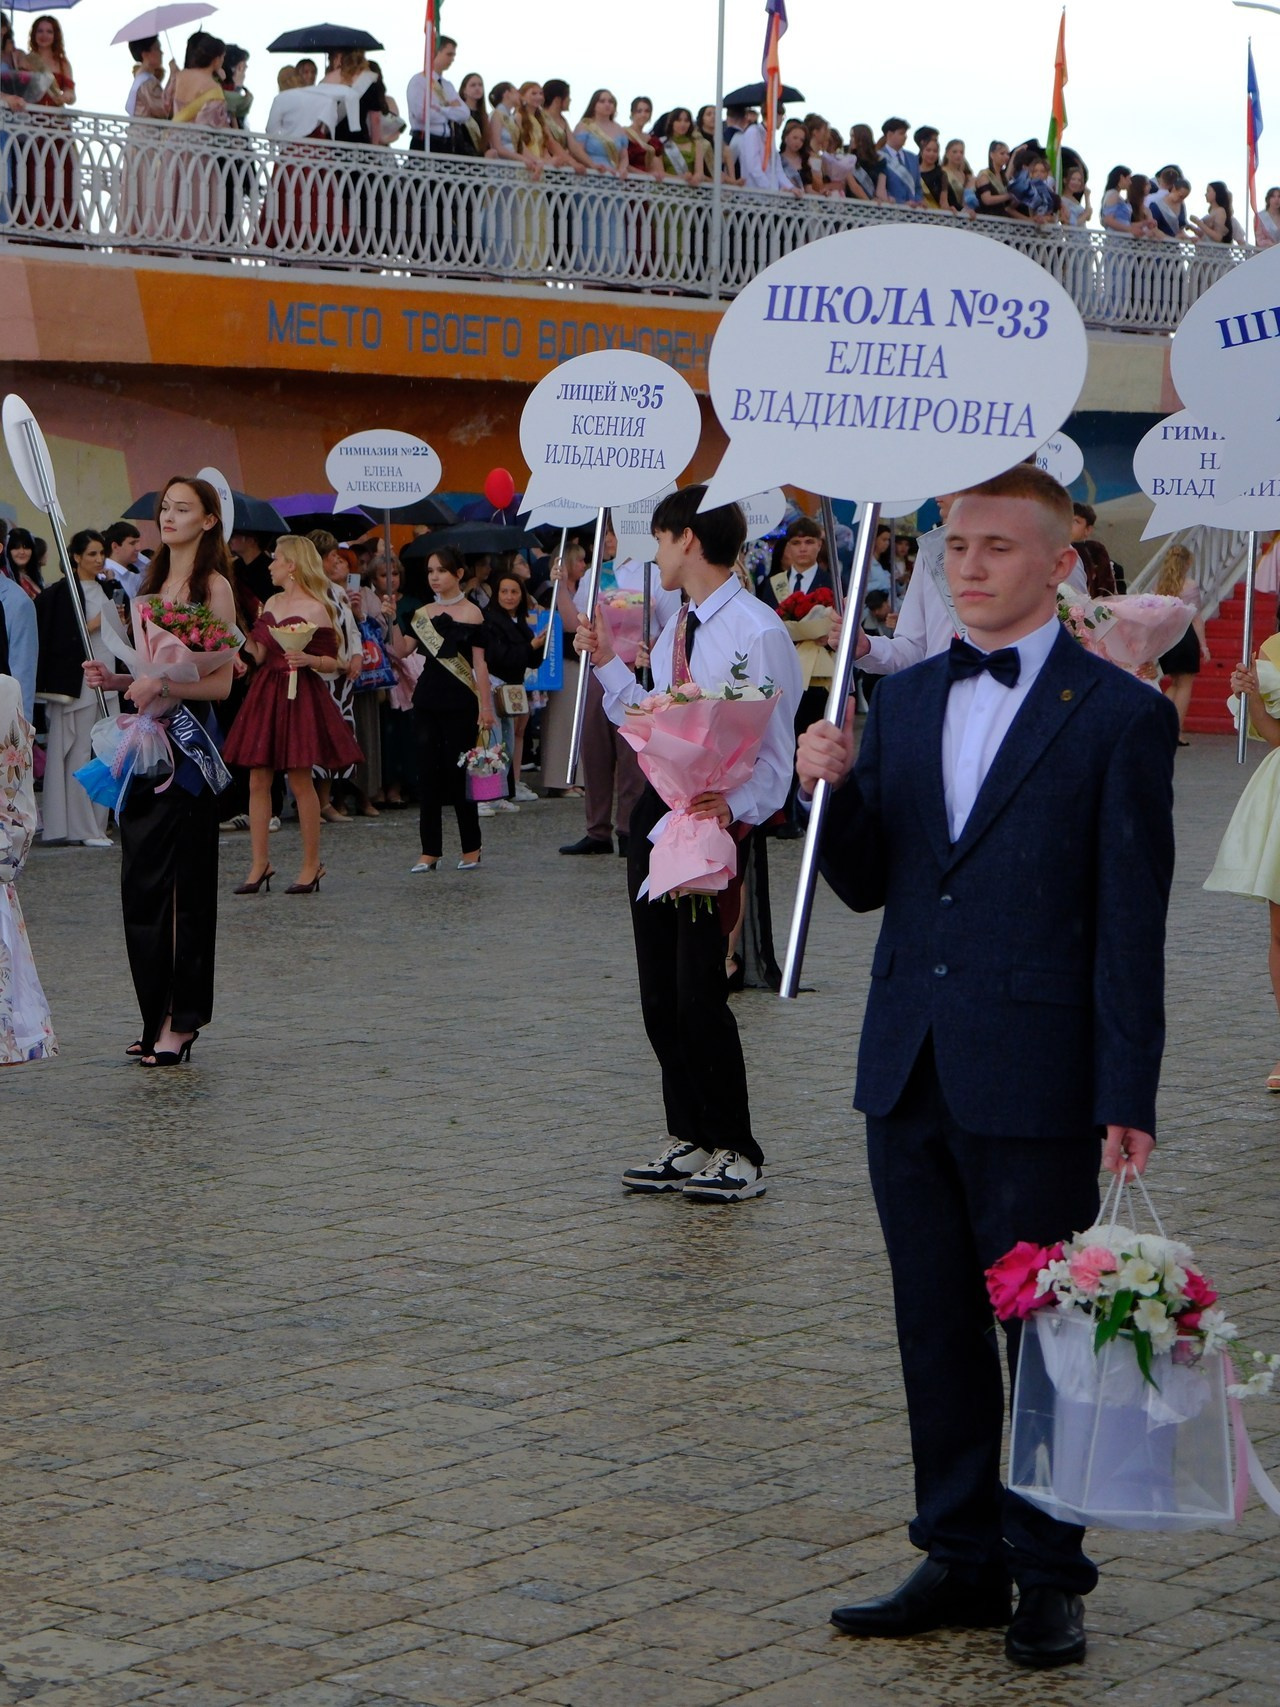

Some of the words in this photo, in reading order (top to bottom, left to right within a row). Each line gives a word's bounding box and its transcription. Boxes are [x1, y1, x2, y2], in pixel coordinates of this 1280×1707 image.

[763, 285, 935, 326] ШКОЛА
[945, 289, 1050, 339] №33
[268, 299, 382, 350] МЕСТО
[402, 310, 522, 358] ТВОЕГО
[538, 319, 715, 370] ВДОХНОВЕН
[825, 341, 948, 379] ЕЛЕНА
[556, 381, 617, 405] ЛИЦЕЙ
[620, 383, 665, 409] №35
[571, 414, 646, 438] КСЕНИЯ
[730, 389, 1037, 438] ВЛАДИМИРОВНА
[339, 446, 398, 457] ГИМНАЗИЯ
[401, 445, 429, 456] №22
[544, 443, 666, 470] ИЛЬДАРОВНА
[364, 466, 403, 477] ЕЛЕНА
[346, 481, 421, 493] АЛЕКСЕЕВНА
[620, 520, 652, 535] НИКОЛА
